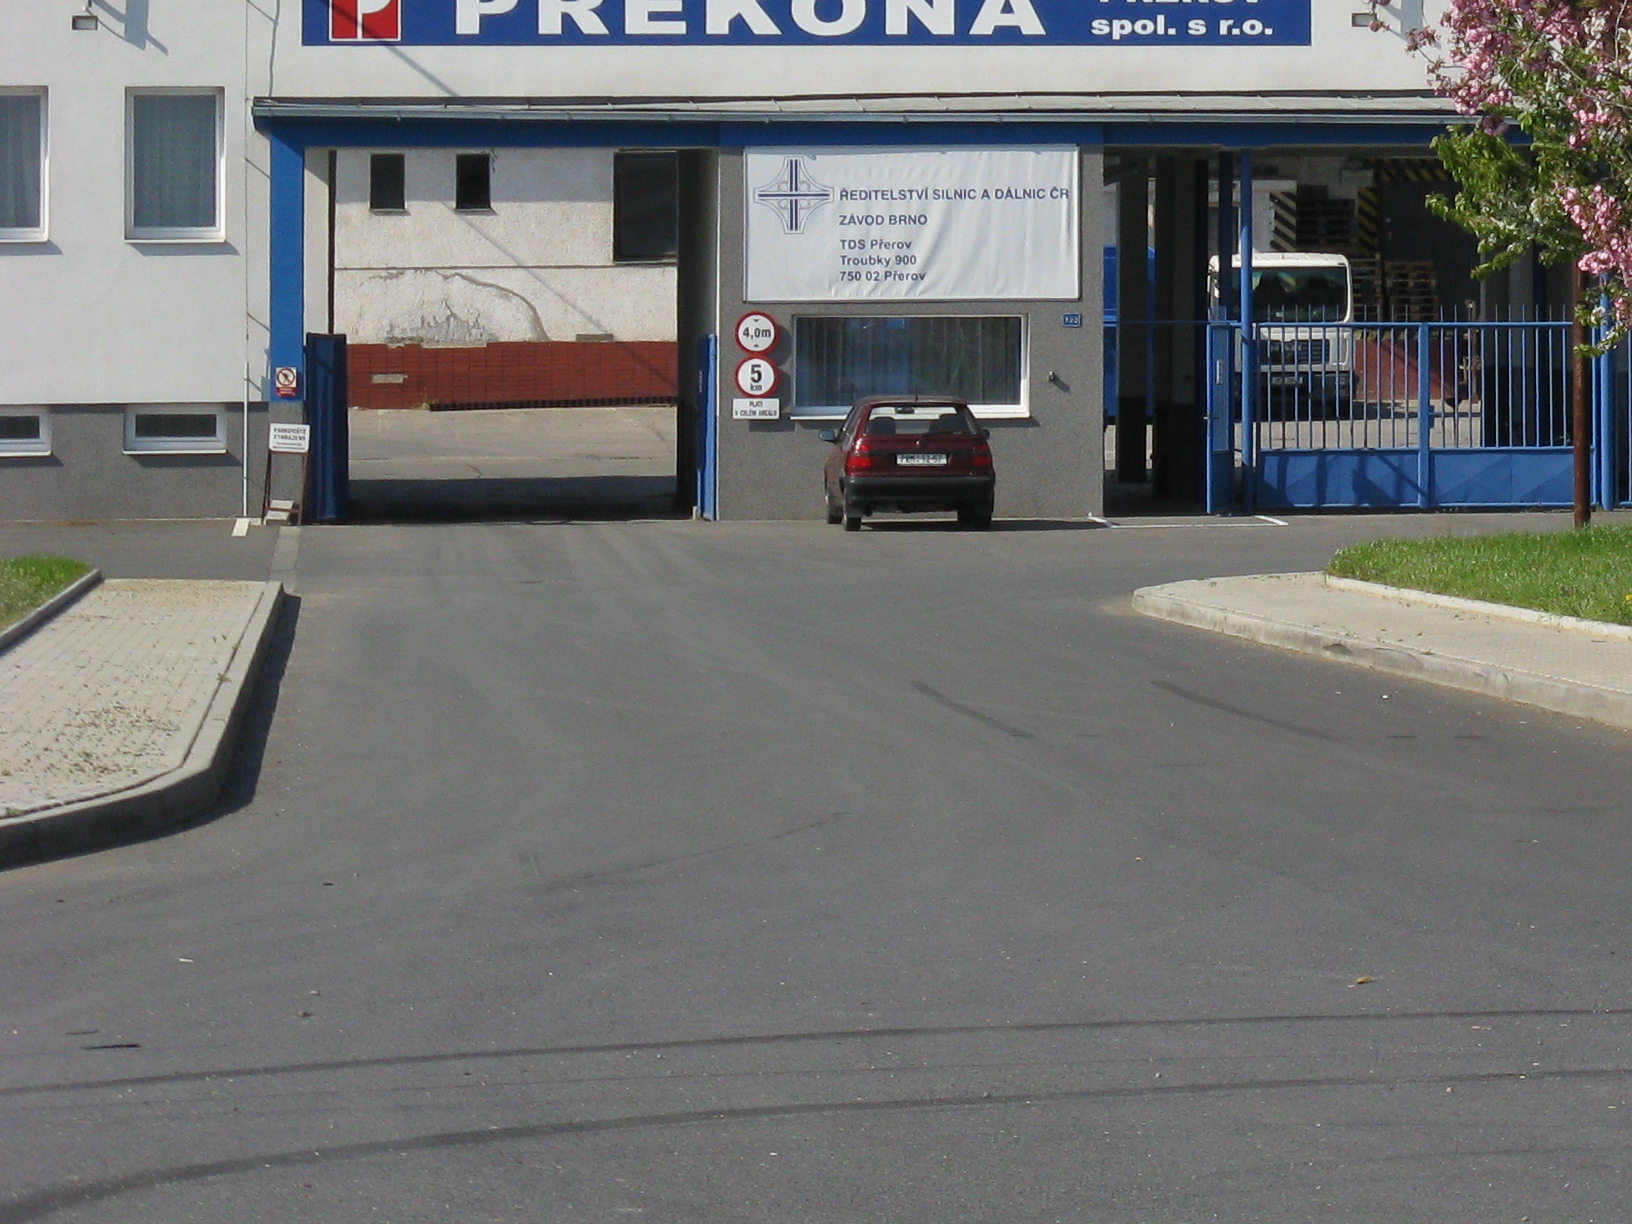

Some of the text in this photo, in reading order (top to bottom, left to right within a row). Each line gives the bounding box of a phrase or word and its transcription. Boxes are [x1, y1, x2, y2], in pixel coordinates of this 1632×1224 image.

[1090, 14, 1274, 41] spol. s r.o.
[839, 185, 1070, 202] ŘEDITELSTVÍ SILNIC A DÁLNIC ČR
[838, 212, 929, 227] ZÁVOD BRNO
[839, 238, 913, 251] TDS Přerov
[839, 254, 917, 268] Troubky 900
[839, 269, 927, 283] 750 02 Přerov
[750, 364, 762, 383] 5
[750, 384, 762, 392] km
